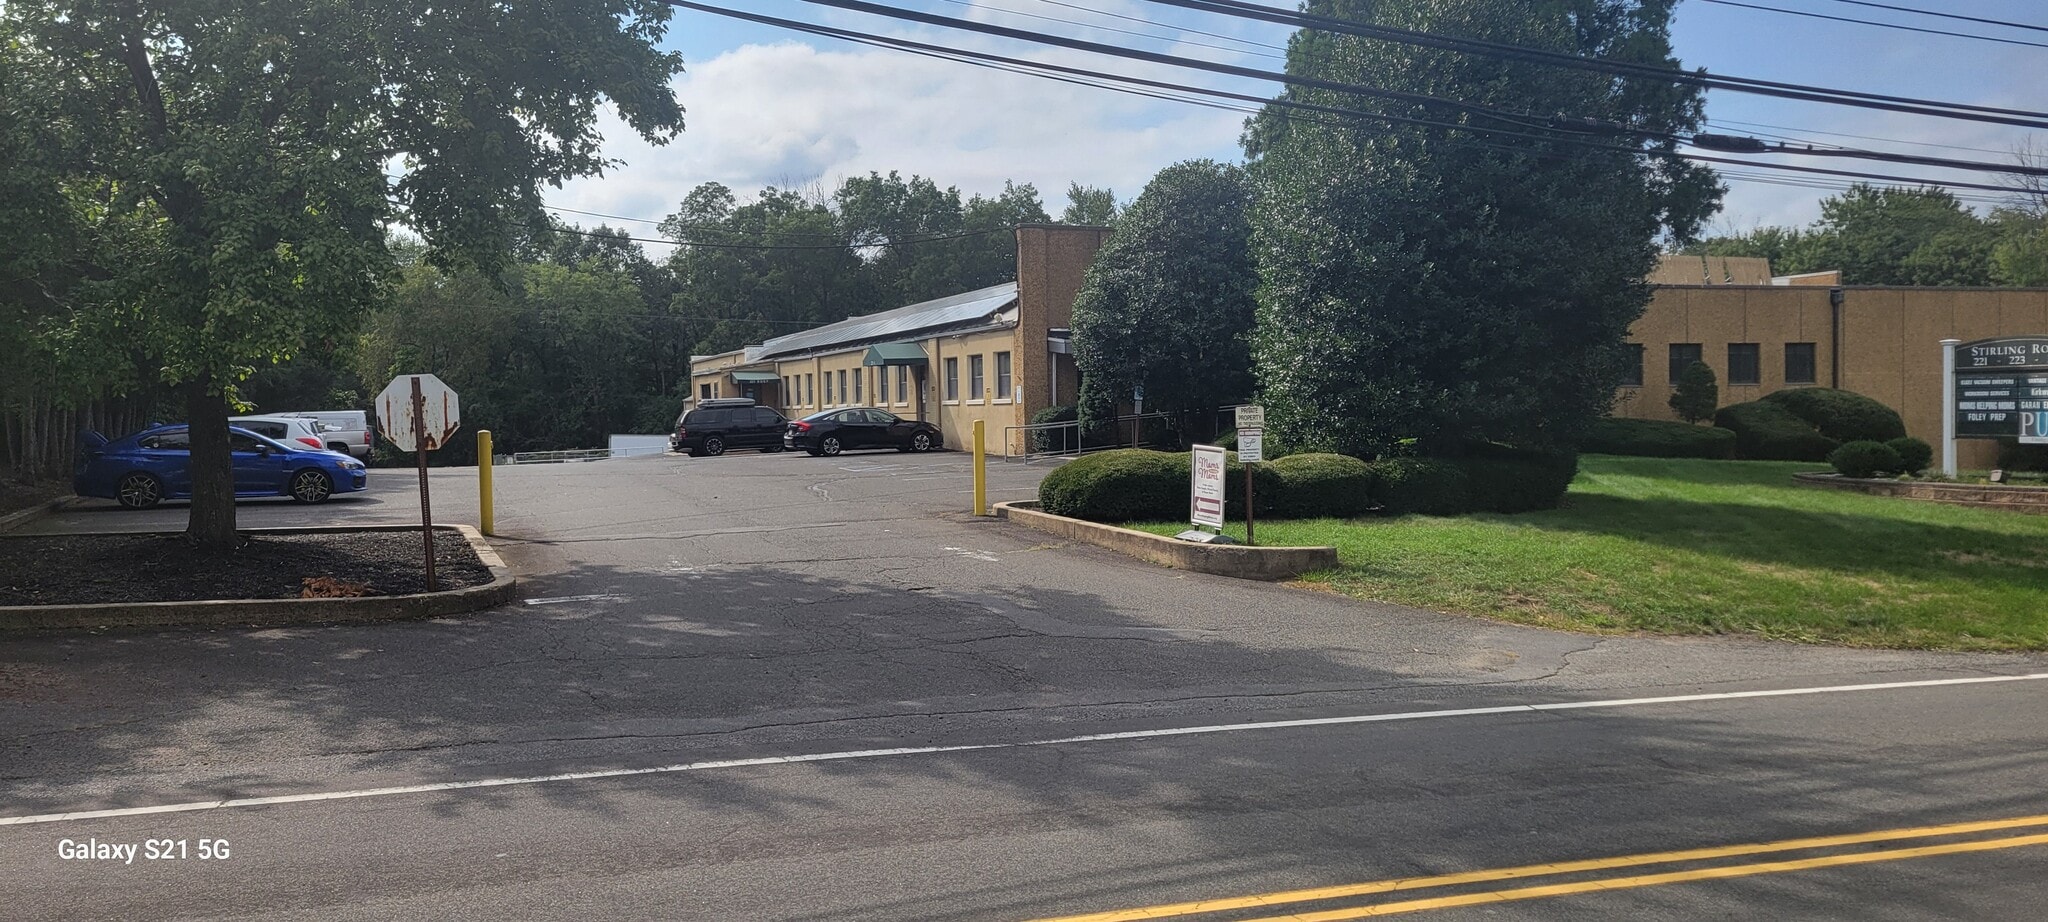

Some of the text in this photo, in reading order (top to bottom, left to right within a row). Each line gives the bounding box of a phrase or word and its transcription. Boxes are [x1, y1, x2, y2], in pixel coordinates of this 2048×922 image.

[1971, 346, 2026, 356] STIRLING
[1973, 357, 1988, 366] 221
[2009, 355, 2026, 365] 223
[1977, 402, 1998, 410] HELPING
[1968, 413, 2006, 421] FOLEY PREP
